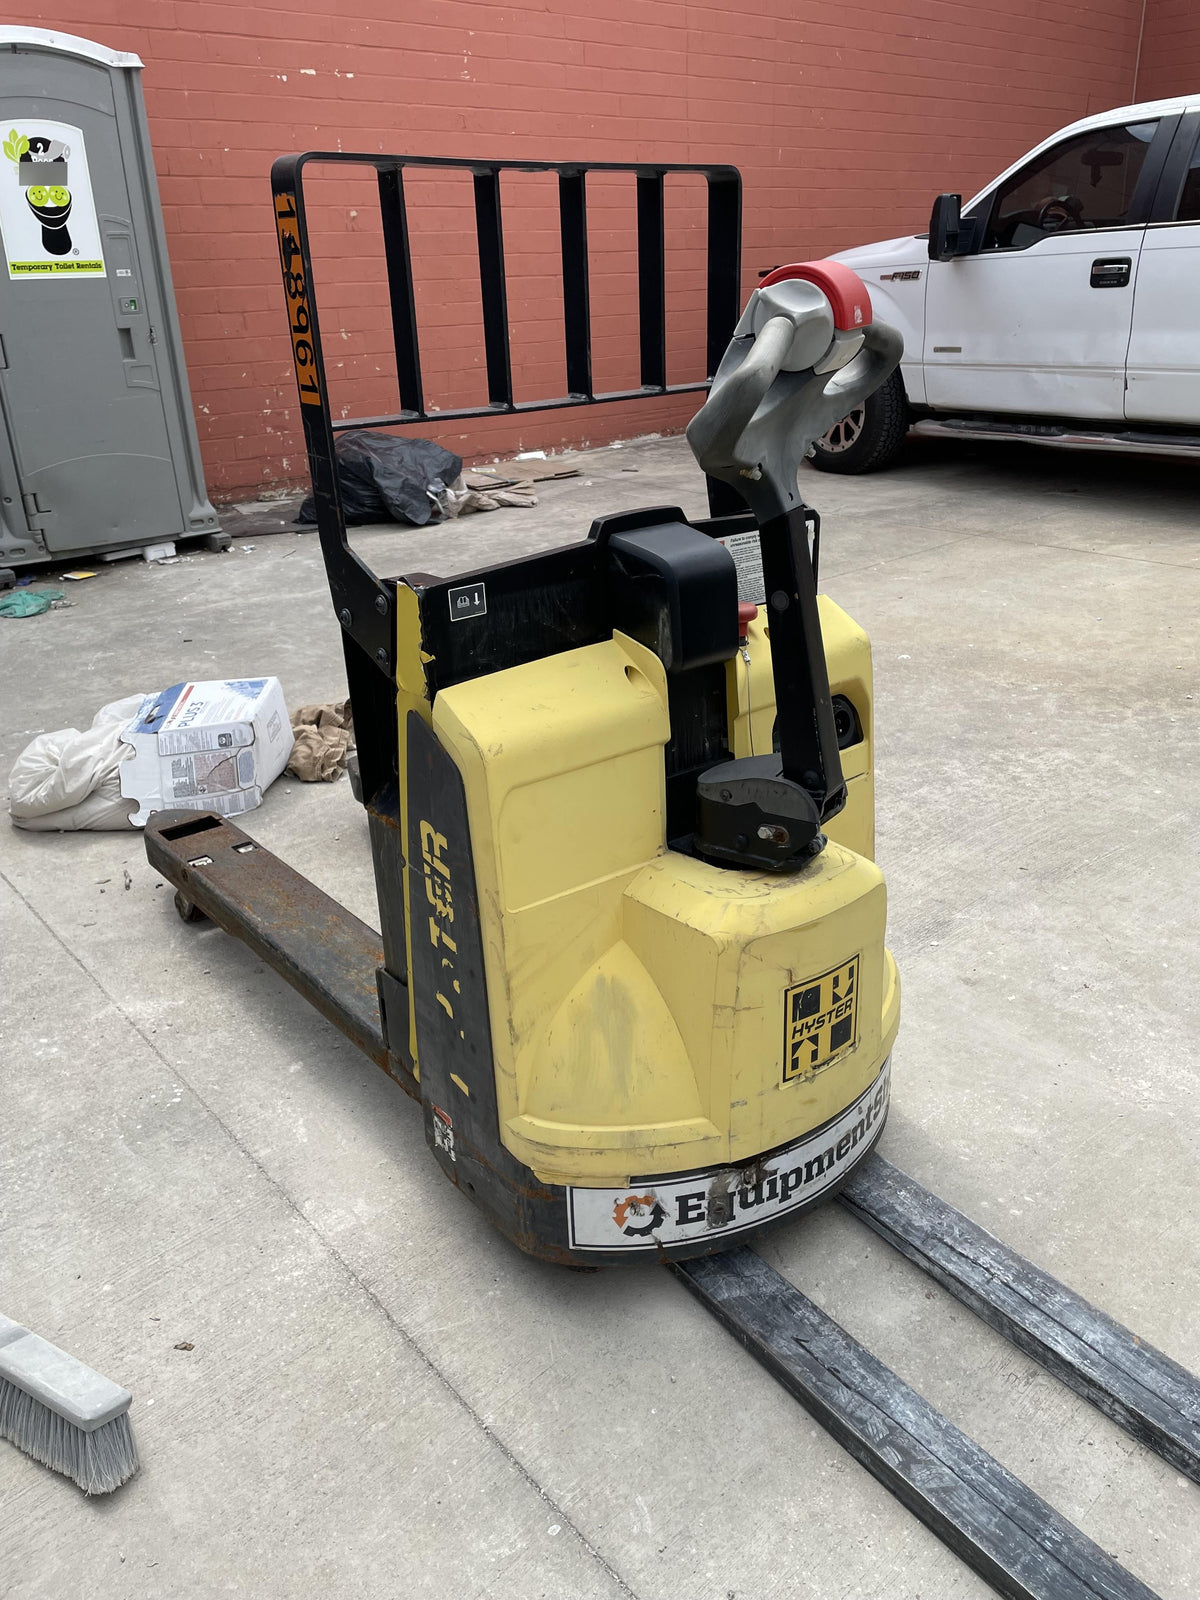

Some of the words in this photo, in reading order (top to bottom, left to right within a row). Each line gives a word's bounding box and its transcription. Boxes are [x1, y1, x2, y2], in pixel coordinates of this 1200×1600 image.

[36, 142, 45, 156] 2
[11, 263, 53, 271] Temporary
[55, 262, 75, 270] Toilet
[791, 997, 853, 1041] HYSTER
